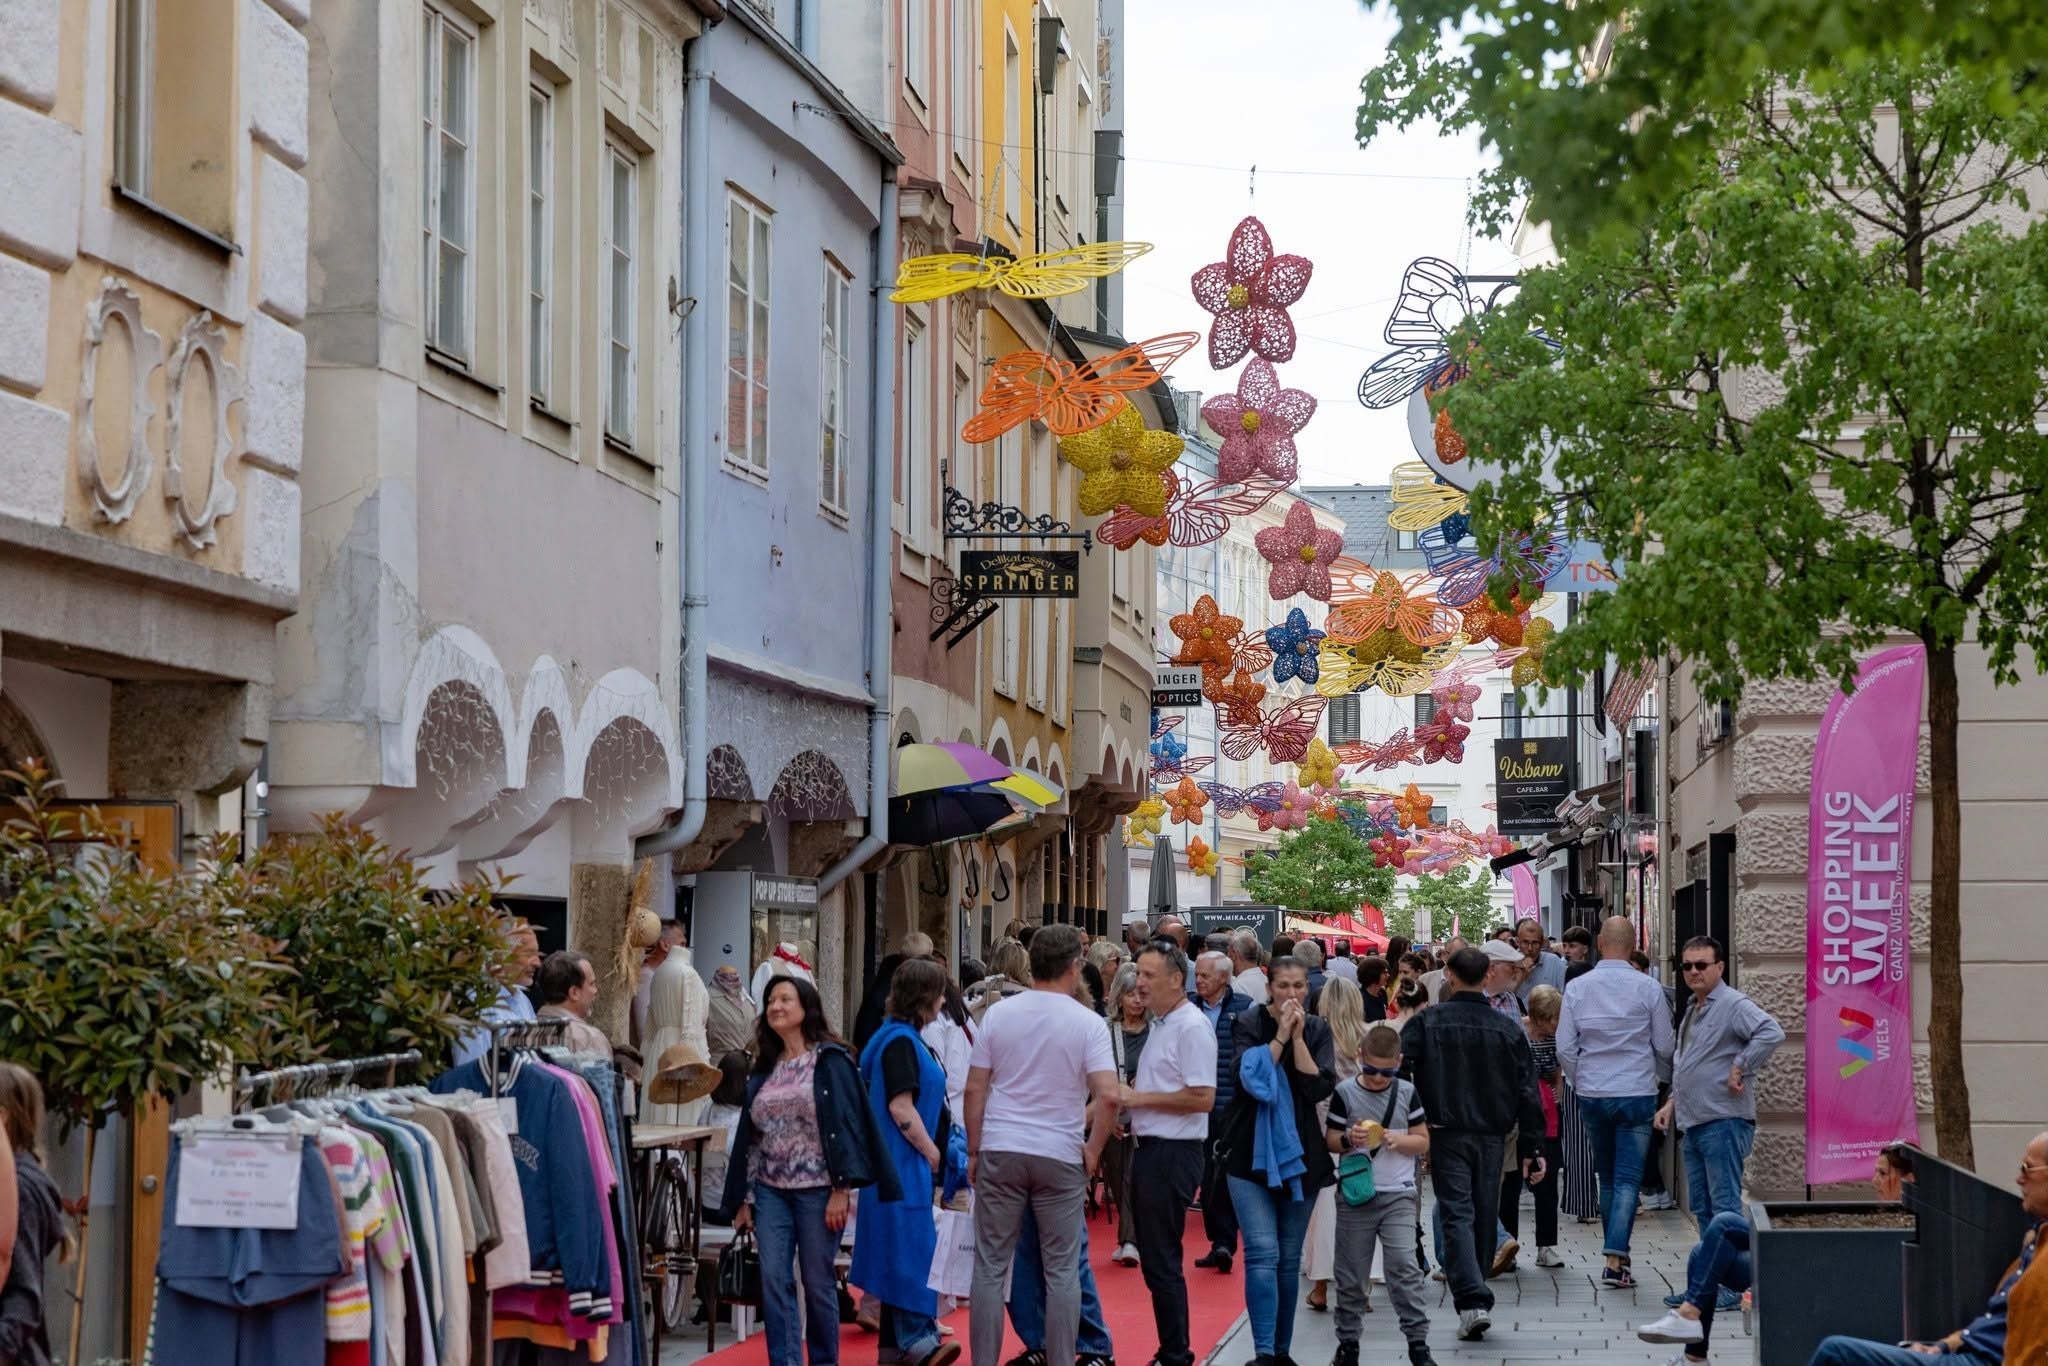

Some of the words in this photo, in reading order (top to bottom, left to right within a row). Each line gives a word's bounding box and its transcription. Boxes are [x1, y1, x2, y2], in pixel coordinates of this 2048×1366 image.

[980, 554, 1056, 571] Delikatessen
[963, 575, 1074, 591] SPRINGER
[1158, 674, 1197, 685] INGER
[1153, 693, 1198, 703] OPTICS
[1500, 756, 1564, 779] Urbann
[755, 880, 768, 900] POP
[768, 881, 777, 902] UP
[1823, 791, 1850, 985] SHOPPING
[1851, 793, 1899, 985] WEEK
[1890, 891, 1903, 933] WELS
[1890, 937, 1903, 982] GANZ
[1876, 1018, 1889, 1061] WELS
